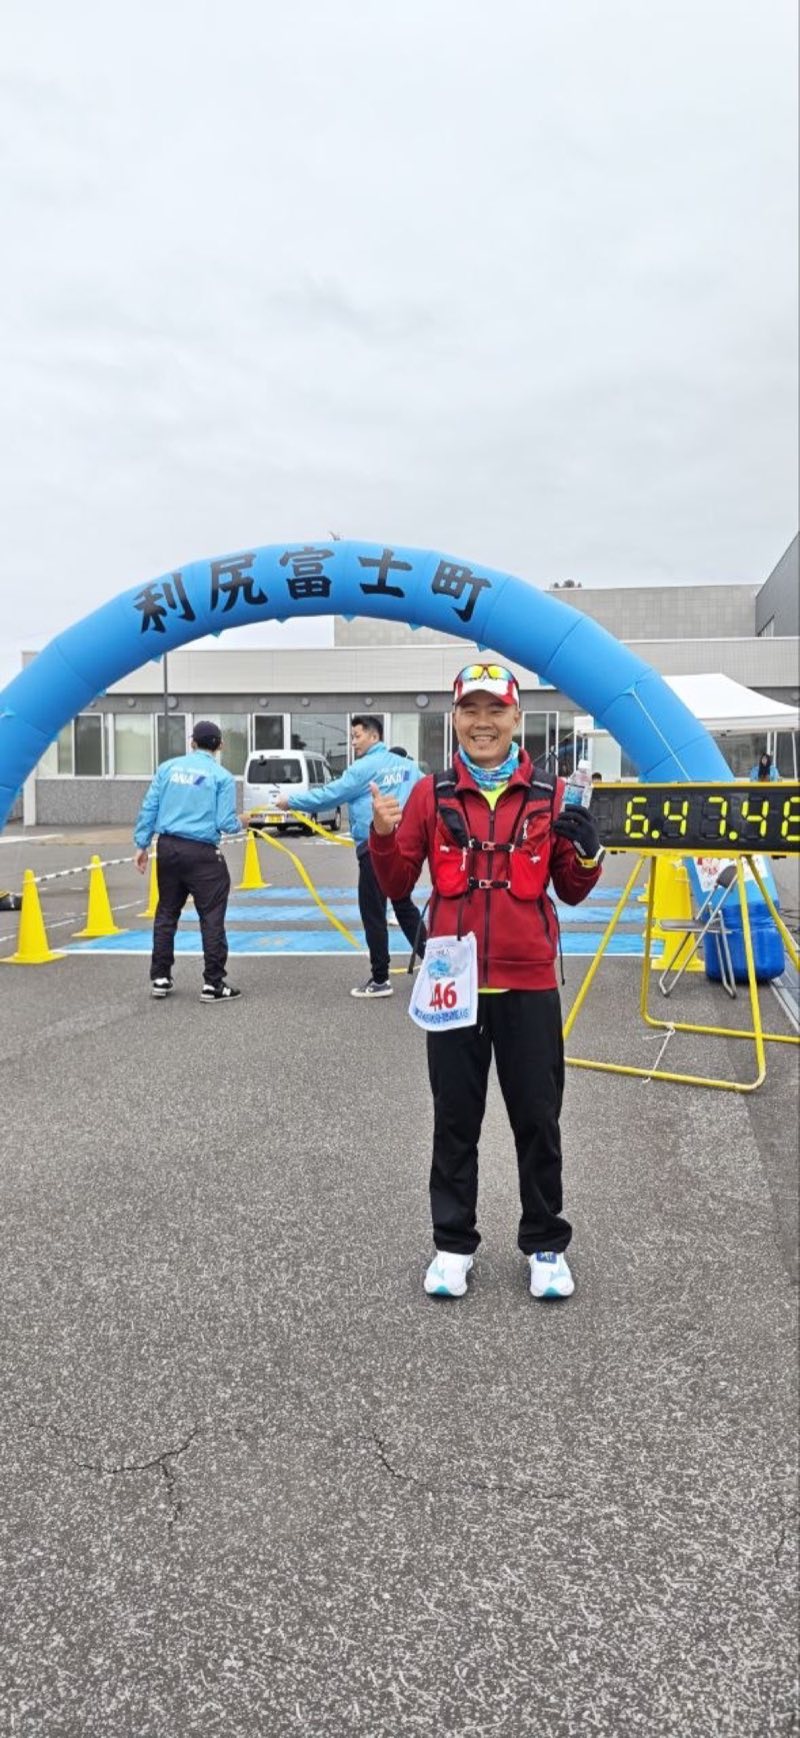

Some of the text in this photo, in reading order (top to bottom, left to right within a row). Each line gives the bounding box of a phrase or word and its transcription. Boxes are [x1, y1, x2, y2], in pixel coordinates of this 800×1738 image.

[133, 546, 492, 634] 利尻富士町
[171, 772, 195, 785] ANA
[429, 981, 458, 1011] 46
